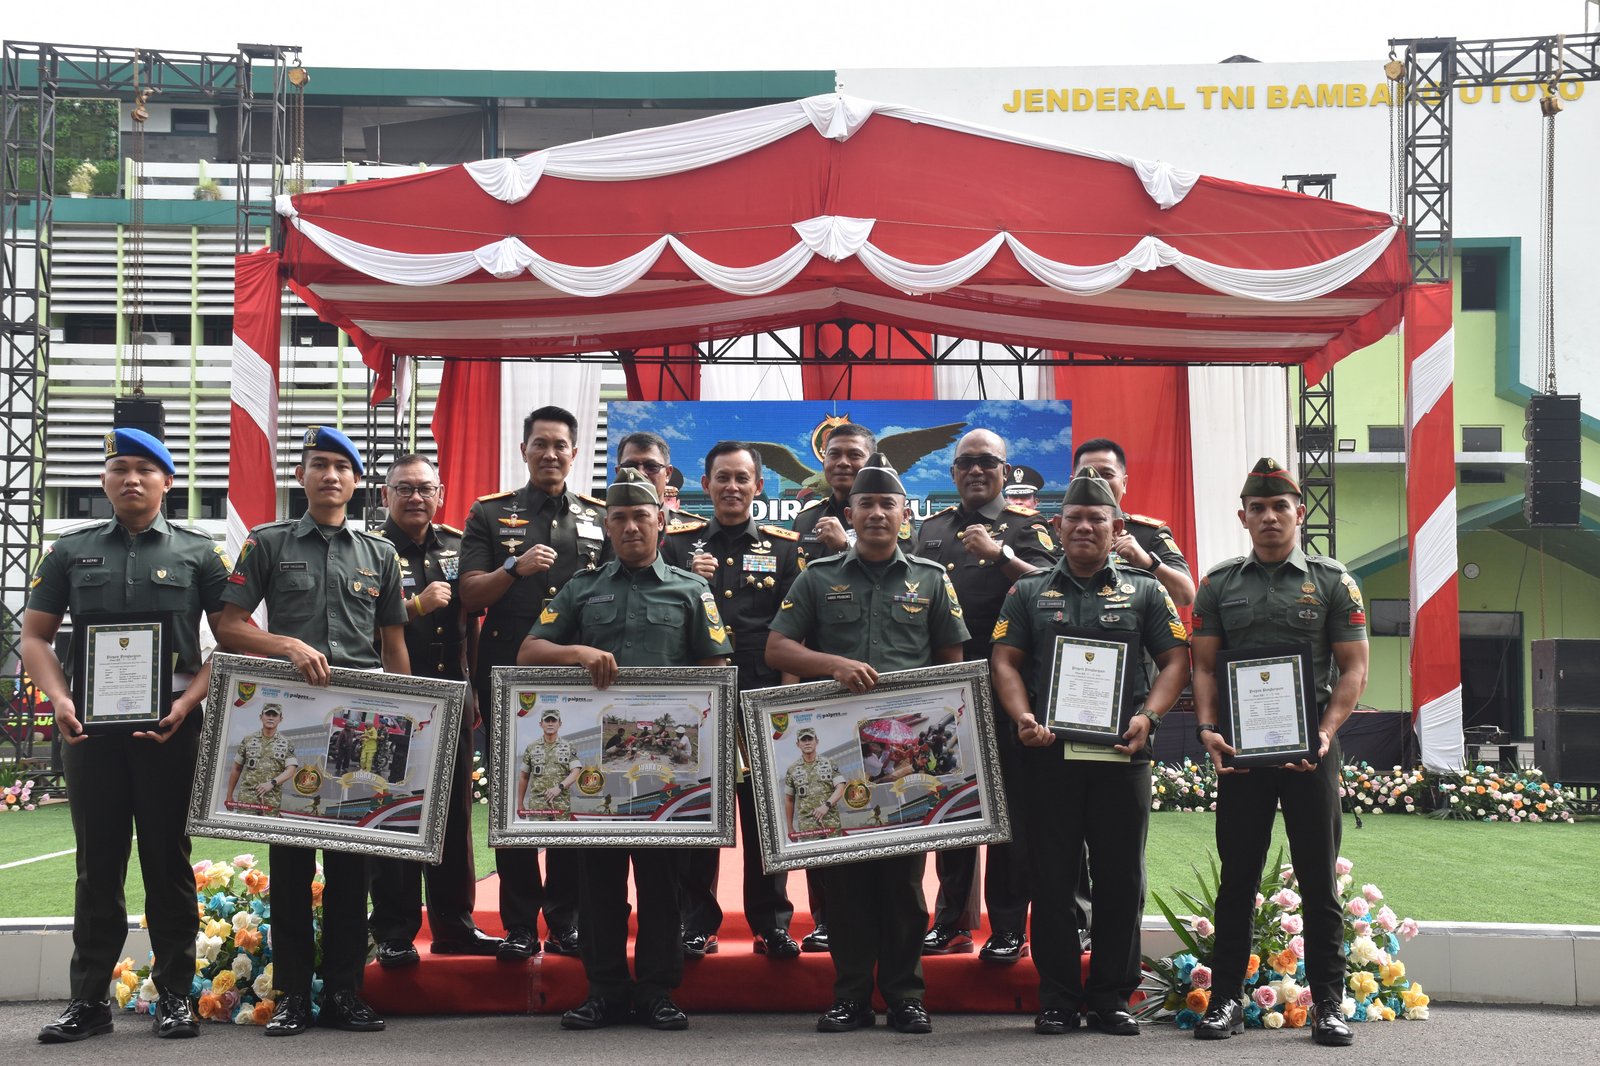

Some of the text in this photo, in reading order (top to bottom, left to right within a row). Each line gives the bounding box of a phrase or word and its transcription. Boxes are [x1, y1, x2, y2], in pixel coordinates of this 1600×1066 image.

[1003, 87, 1185, 113] JENDERAL
[1196, 86, 1255, 110] TNI
[1267, 80, 1444, 108] BAMBAG
